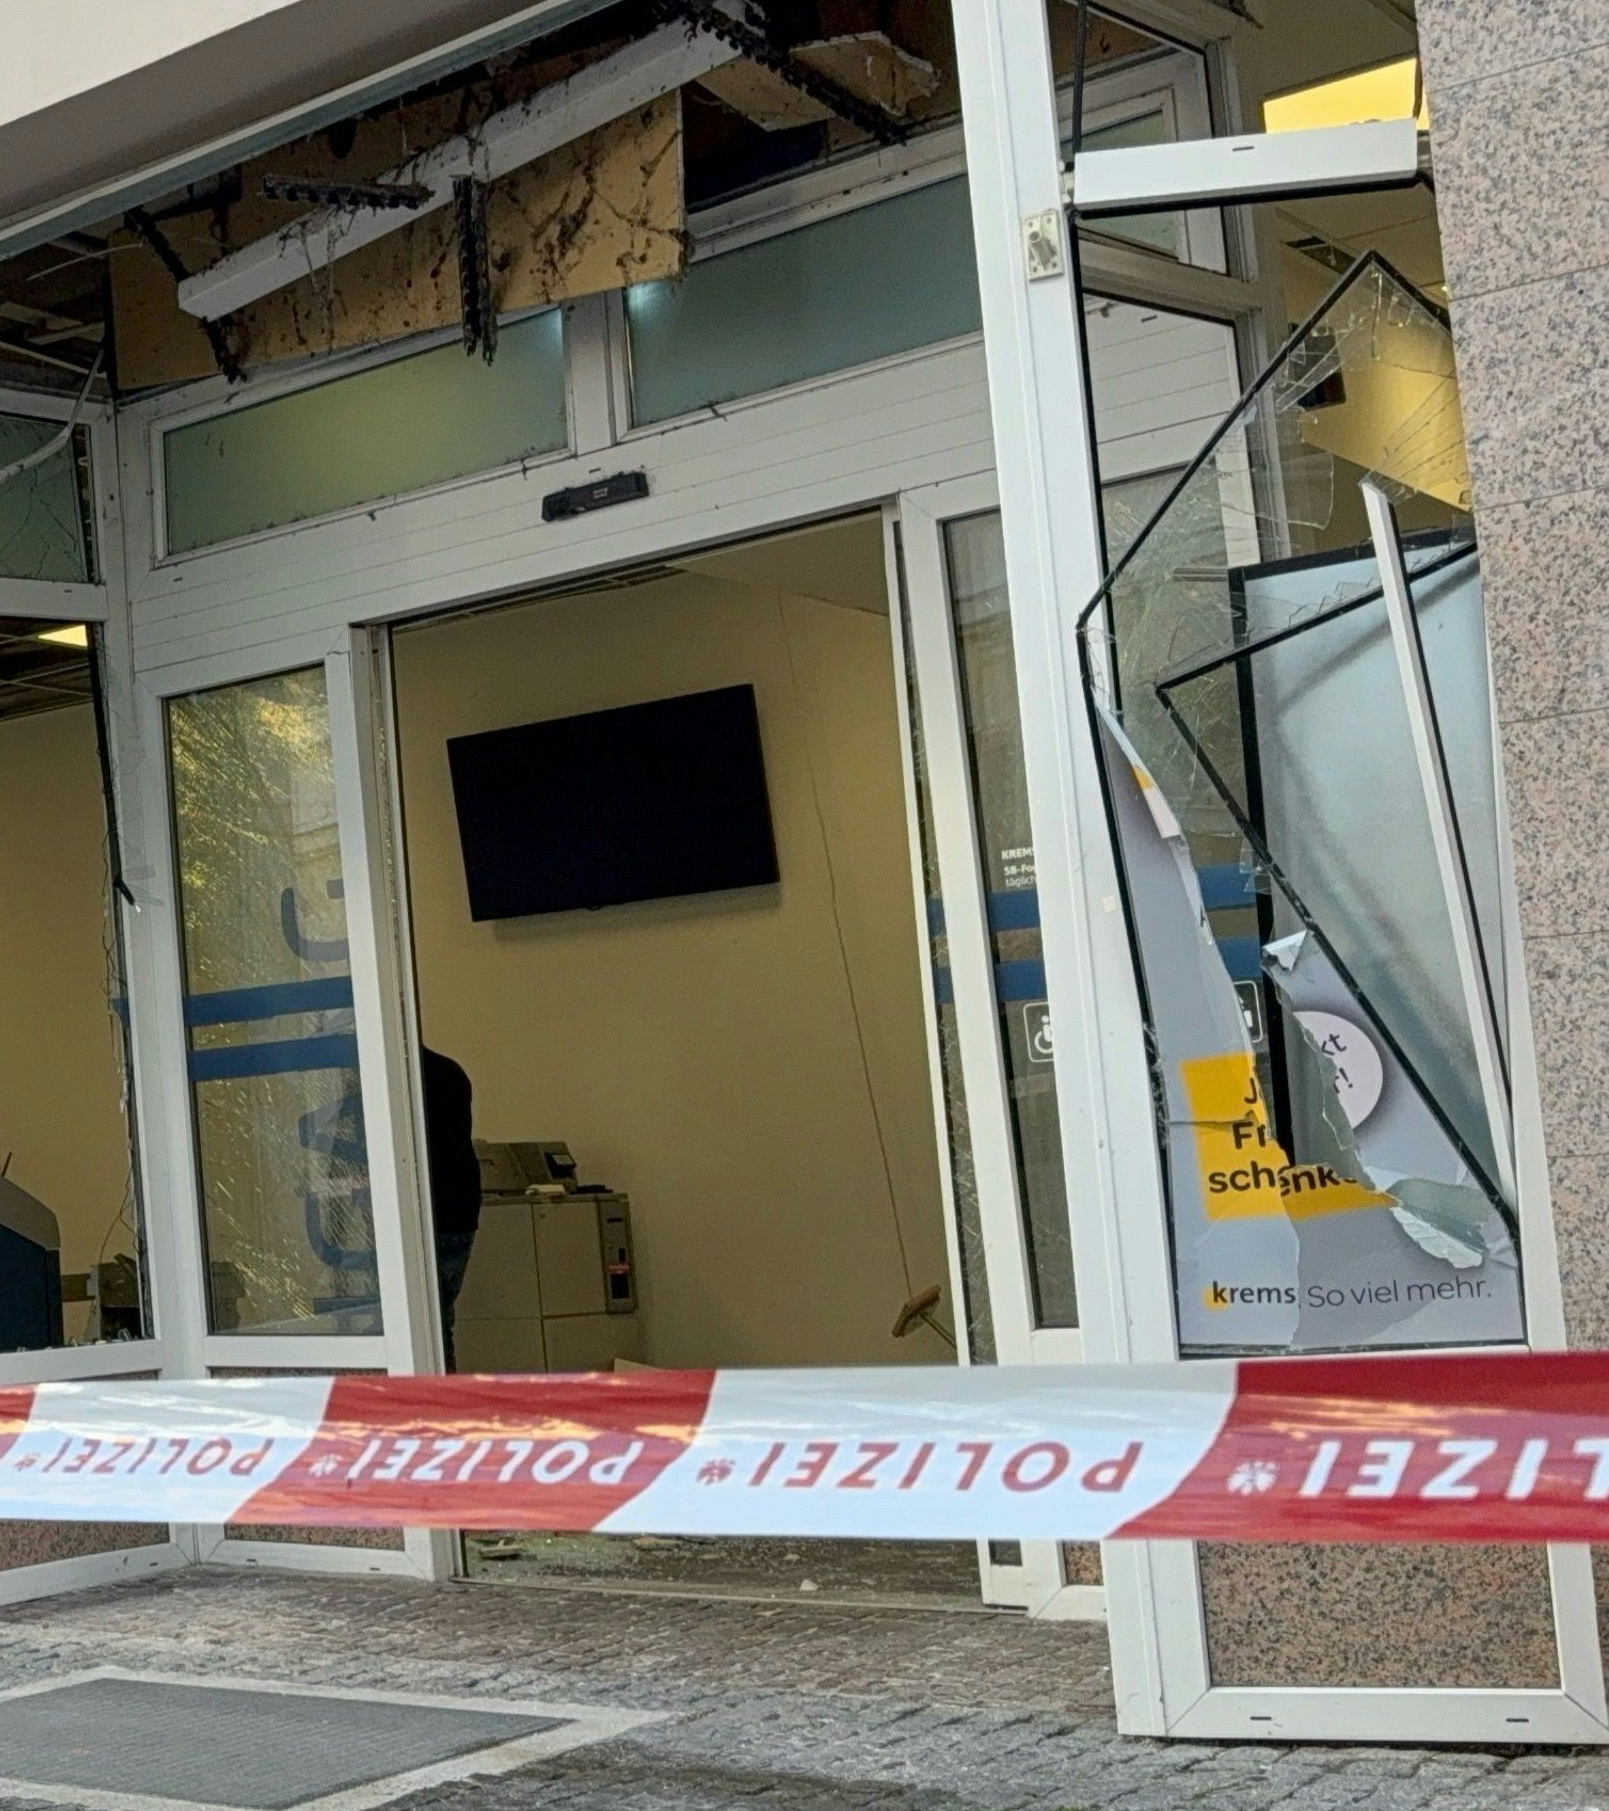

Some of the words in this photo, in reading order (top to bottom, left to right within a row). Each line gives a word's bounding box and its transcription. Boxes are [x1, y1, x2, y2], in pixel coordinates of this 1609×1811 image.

[1001, 847, 1034, 860] KREM
[1208, 1160, 1358, 1197] schenk
[1212, 1281, 1297, 1304] krems
[1308, 1285, 1345, 1309] So
[1350, 1280, 1398, 1304] viel
[1407, 1276, 1493, 1301] mehr.
[42, 1437, 275, 1476] POLIZEI
[345, 1438, 645, 1484] POLIZEI
[748, 1441, 1144, 1493] POLIZEI
